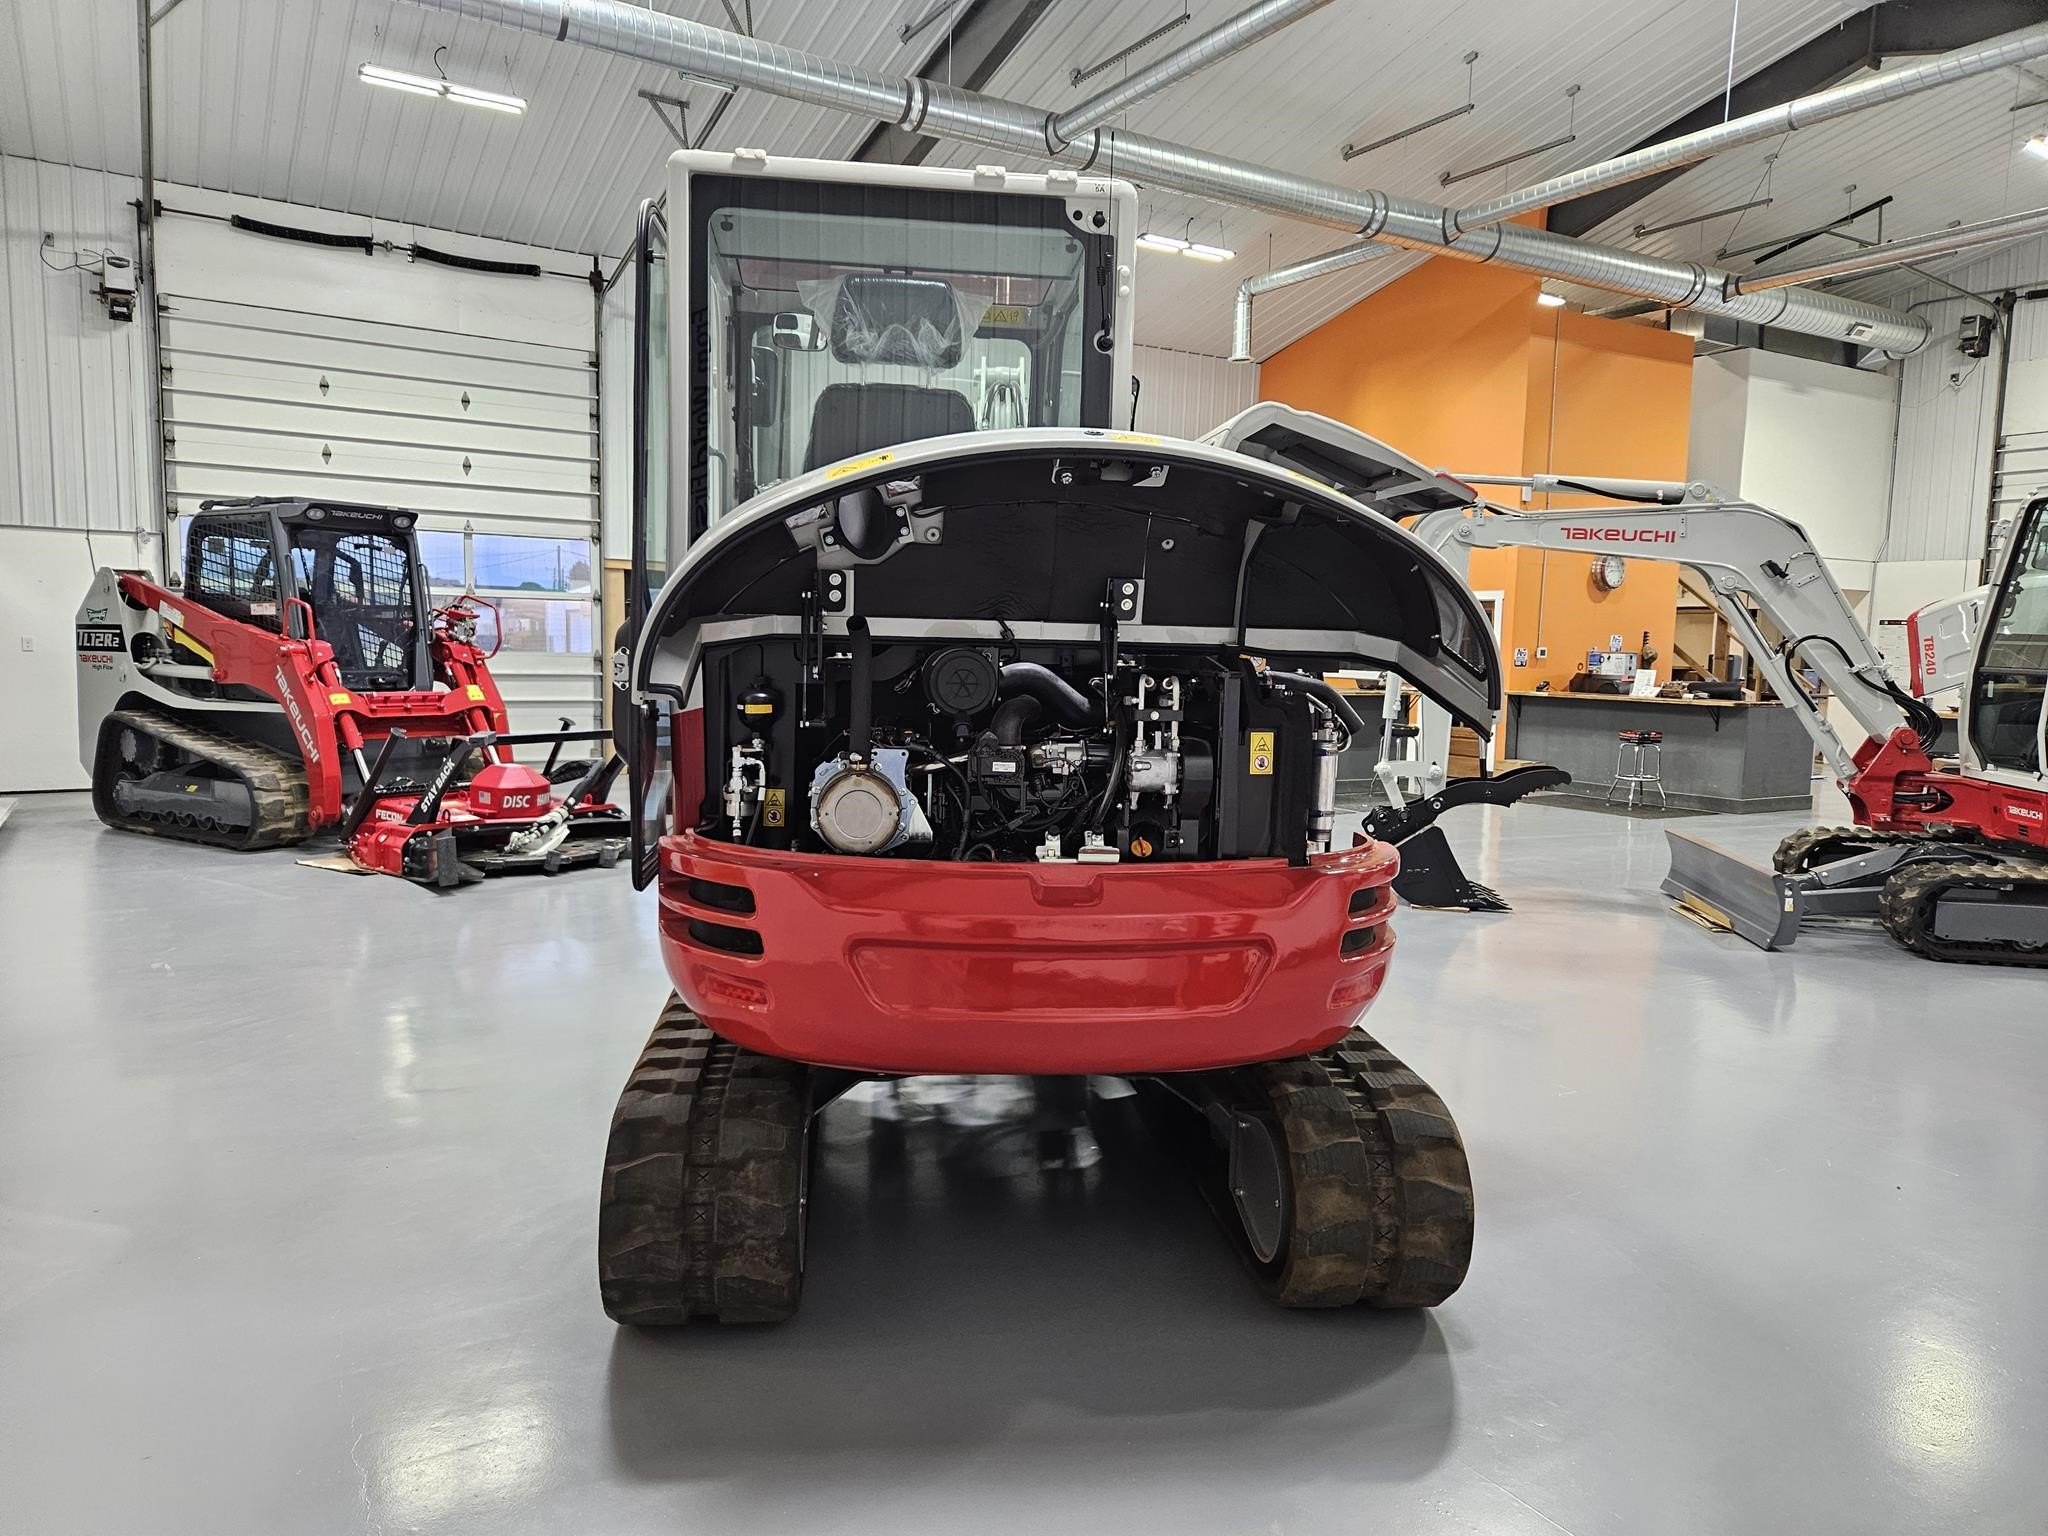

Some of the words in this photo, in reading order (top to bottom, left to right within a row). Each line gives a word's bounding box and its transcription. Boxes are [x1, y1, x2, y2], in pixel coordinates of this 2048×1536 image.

[330, 509, 384, 521] TAKEUCHI
[1560, 527, 1676, 544] TAKEUCHI
[79, 654, 113, 664] TAKEUCHI
[1923, 635, 1937, 676] TB240
[275, 664, 320, 764] TAKEUCHI
[420, 784, 439, 814] STAY
[435, 758, 456, 791] BACK
[502, 795, 531, 809] DISC
[375, 808, 404, 823] FECON
[2007, 805, 2044, 821] TAKEUCHI
